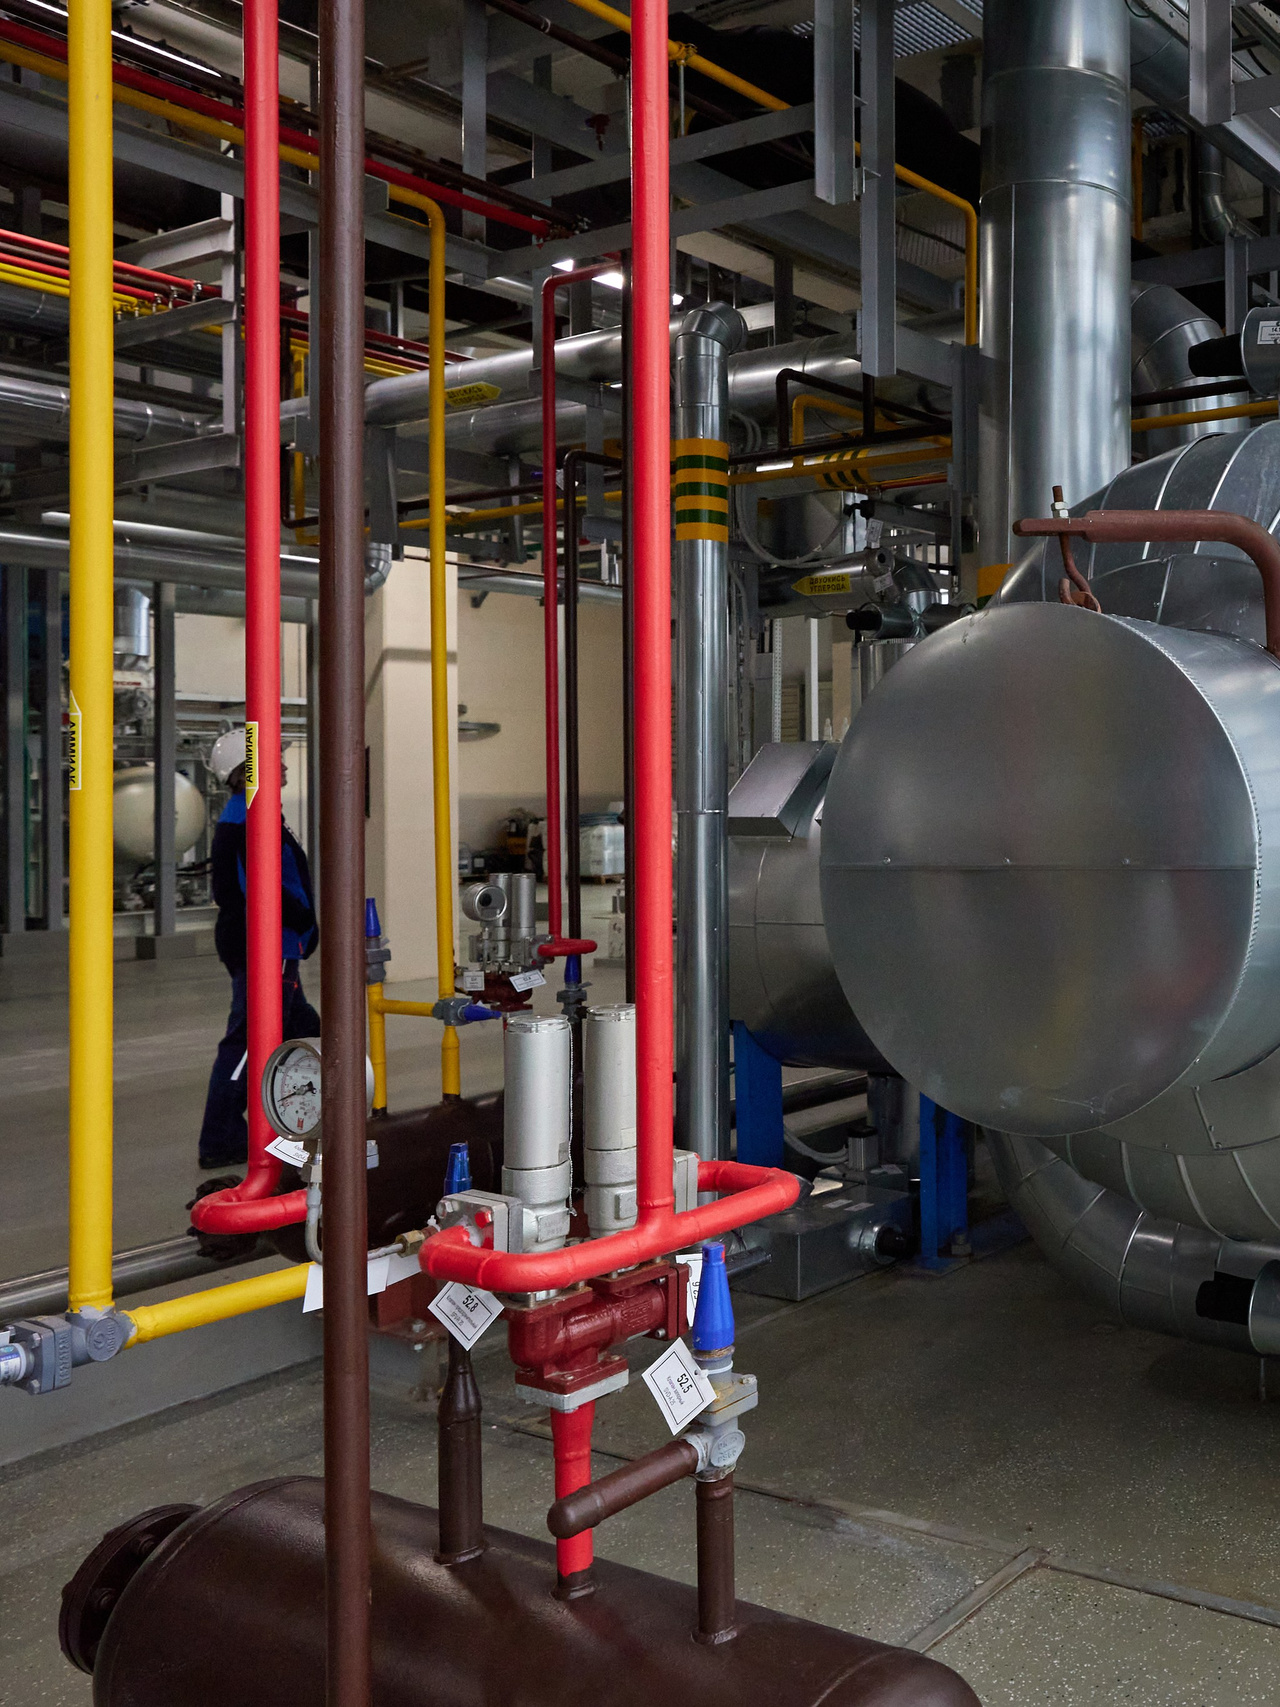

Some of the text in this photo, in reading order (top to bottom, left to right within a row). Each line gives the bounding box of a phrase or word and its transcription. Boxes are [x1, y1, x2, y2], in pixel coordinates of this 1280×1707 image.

[245, 727, 253, 783] АММИАК
[462, 1294, 479, 1313] 52.8
[676, 1373, 693, 1394] 52.5
